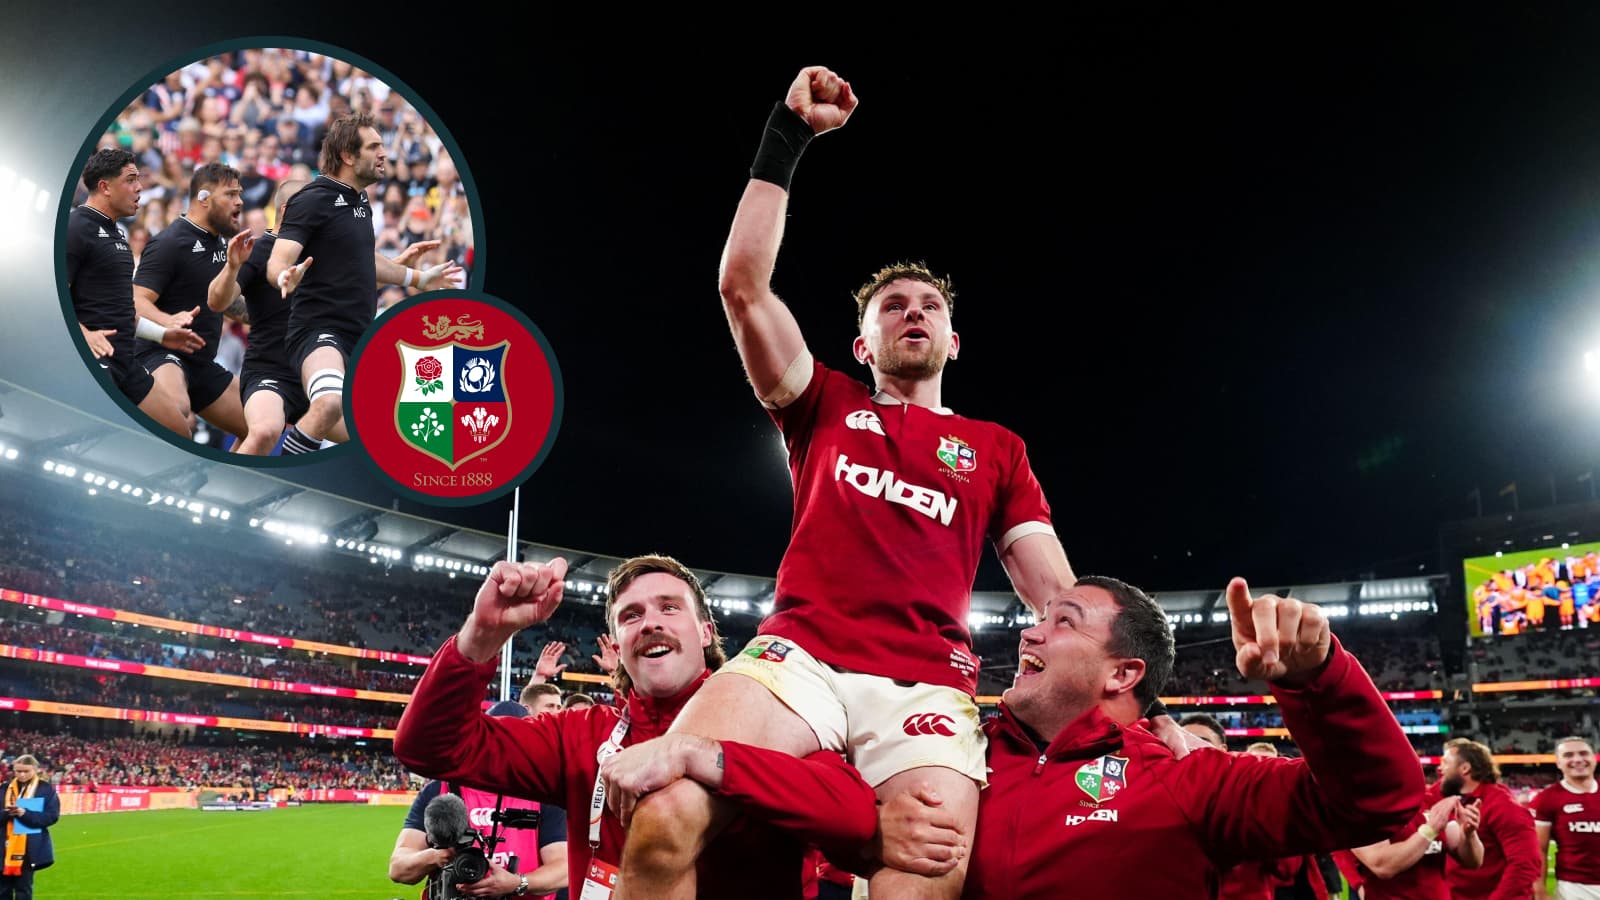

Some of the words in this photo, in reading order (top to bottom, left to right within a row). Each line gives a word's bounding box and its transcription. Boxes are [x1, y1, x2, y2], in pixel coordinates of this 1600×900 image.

[353, 206, 366, 218] AIG
[212, 250, 227, 264] AIG
[835, 454, 958, 527] HOWDEN
[593, 787, 604, 809] FIELD
[1065, 809, 1118, 826] HODEN
